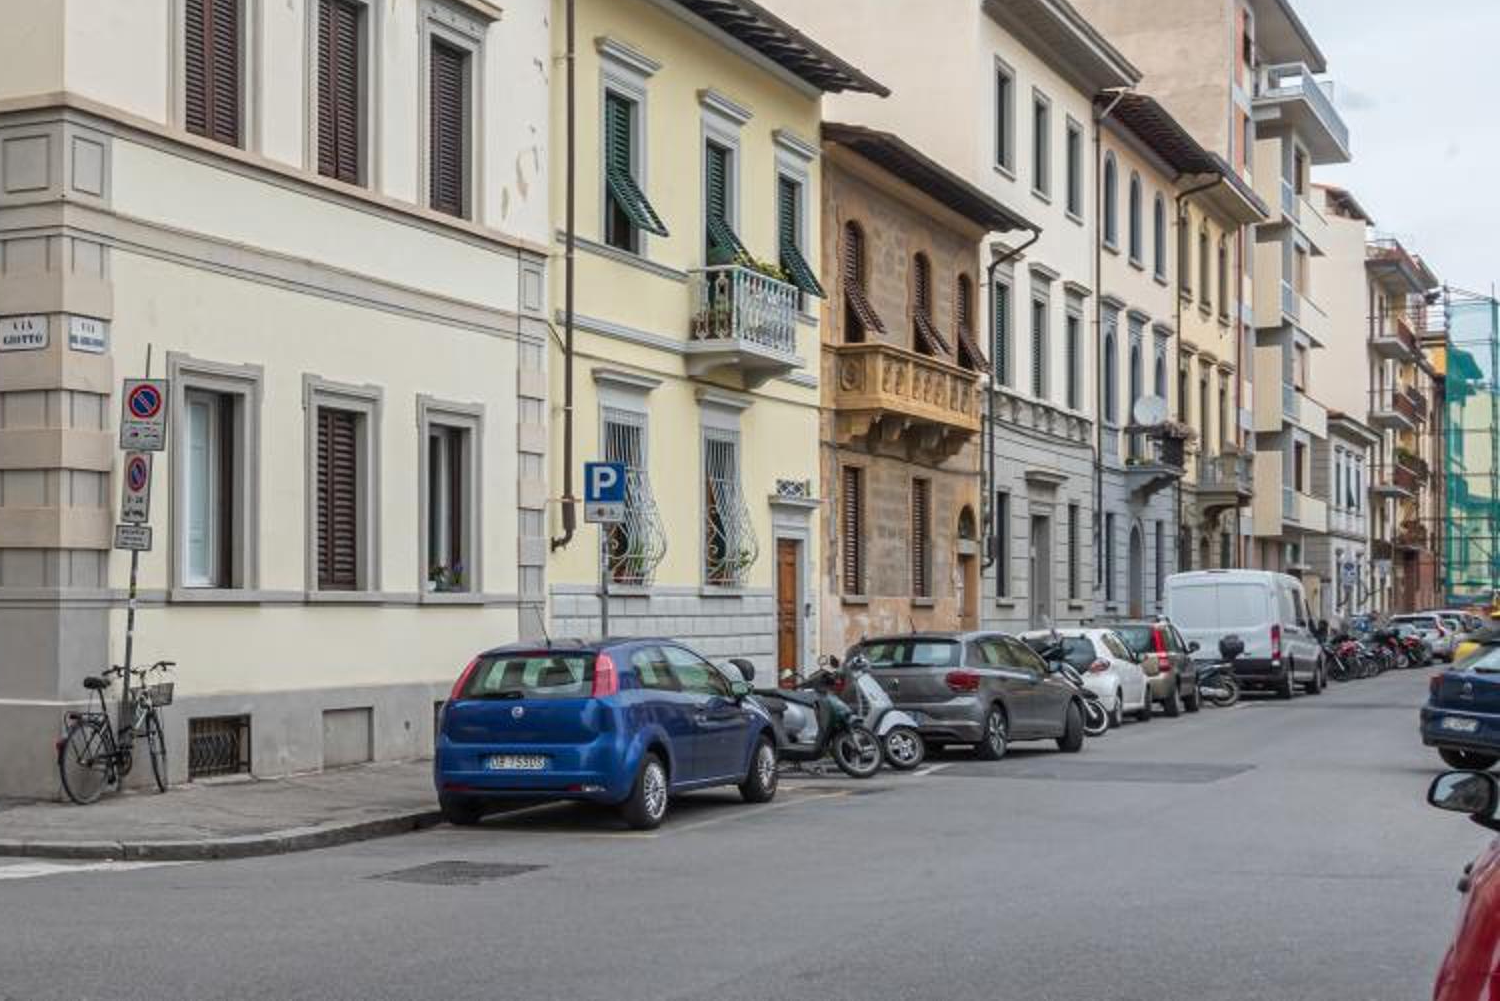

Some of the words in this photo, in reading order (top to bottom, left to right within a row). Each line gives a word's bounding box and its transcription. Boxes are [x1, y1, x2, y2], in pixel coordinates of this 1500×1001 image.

[12, 320, 34, 331] VIA
[3, 333, 43, 345] GIOTTO
[593, 466, 617, 499] P
